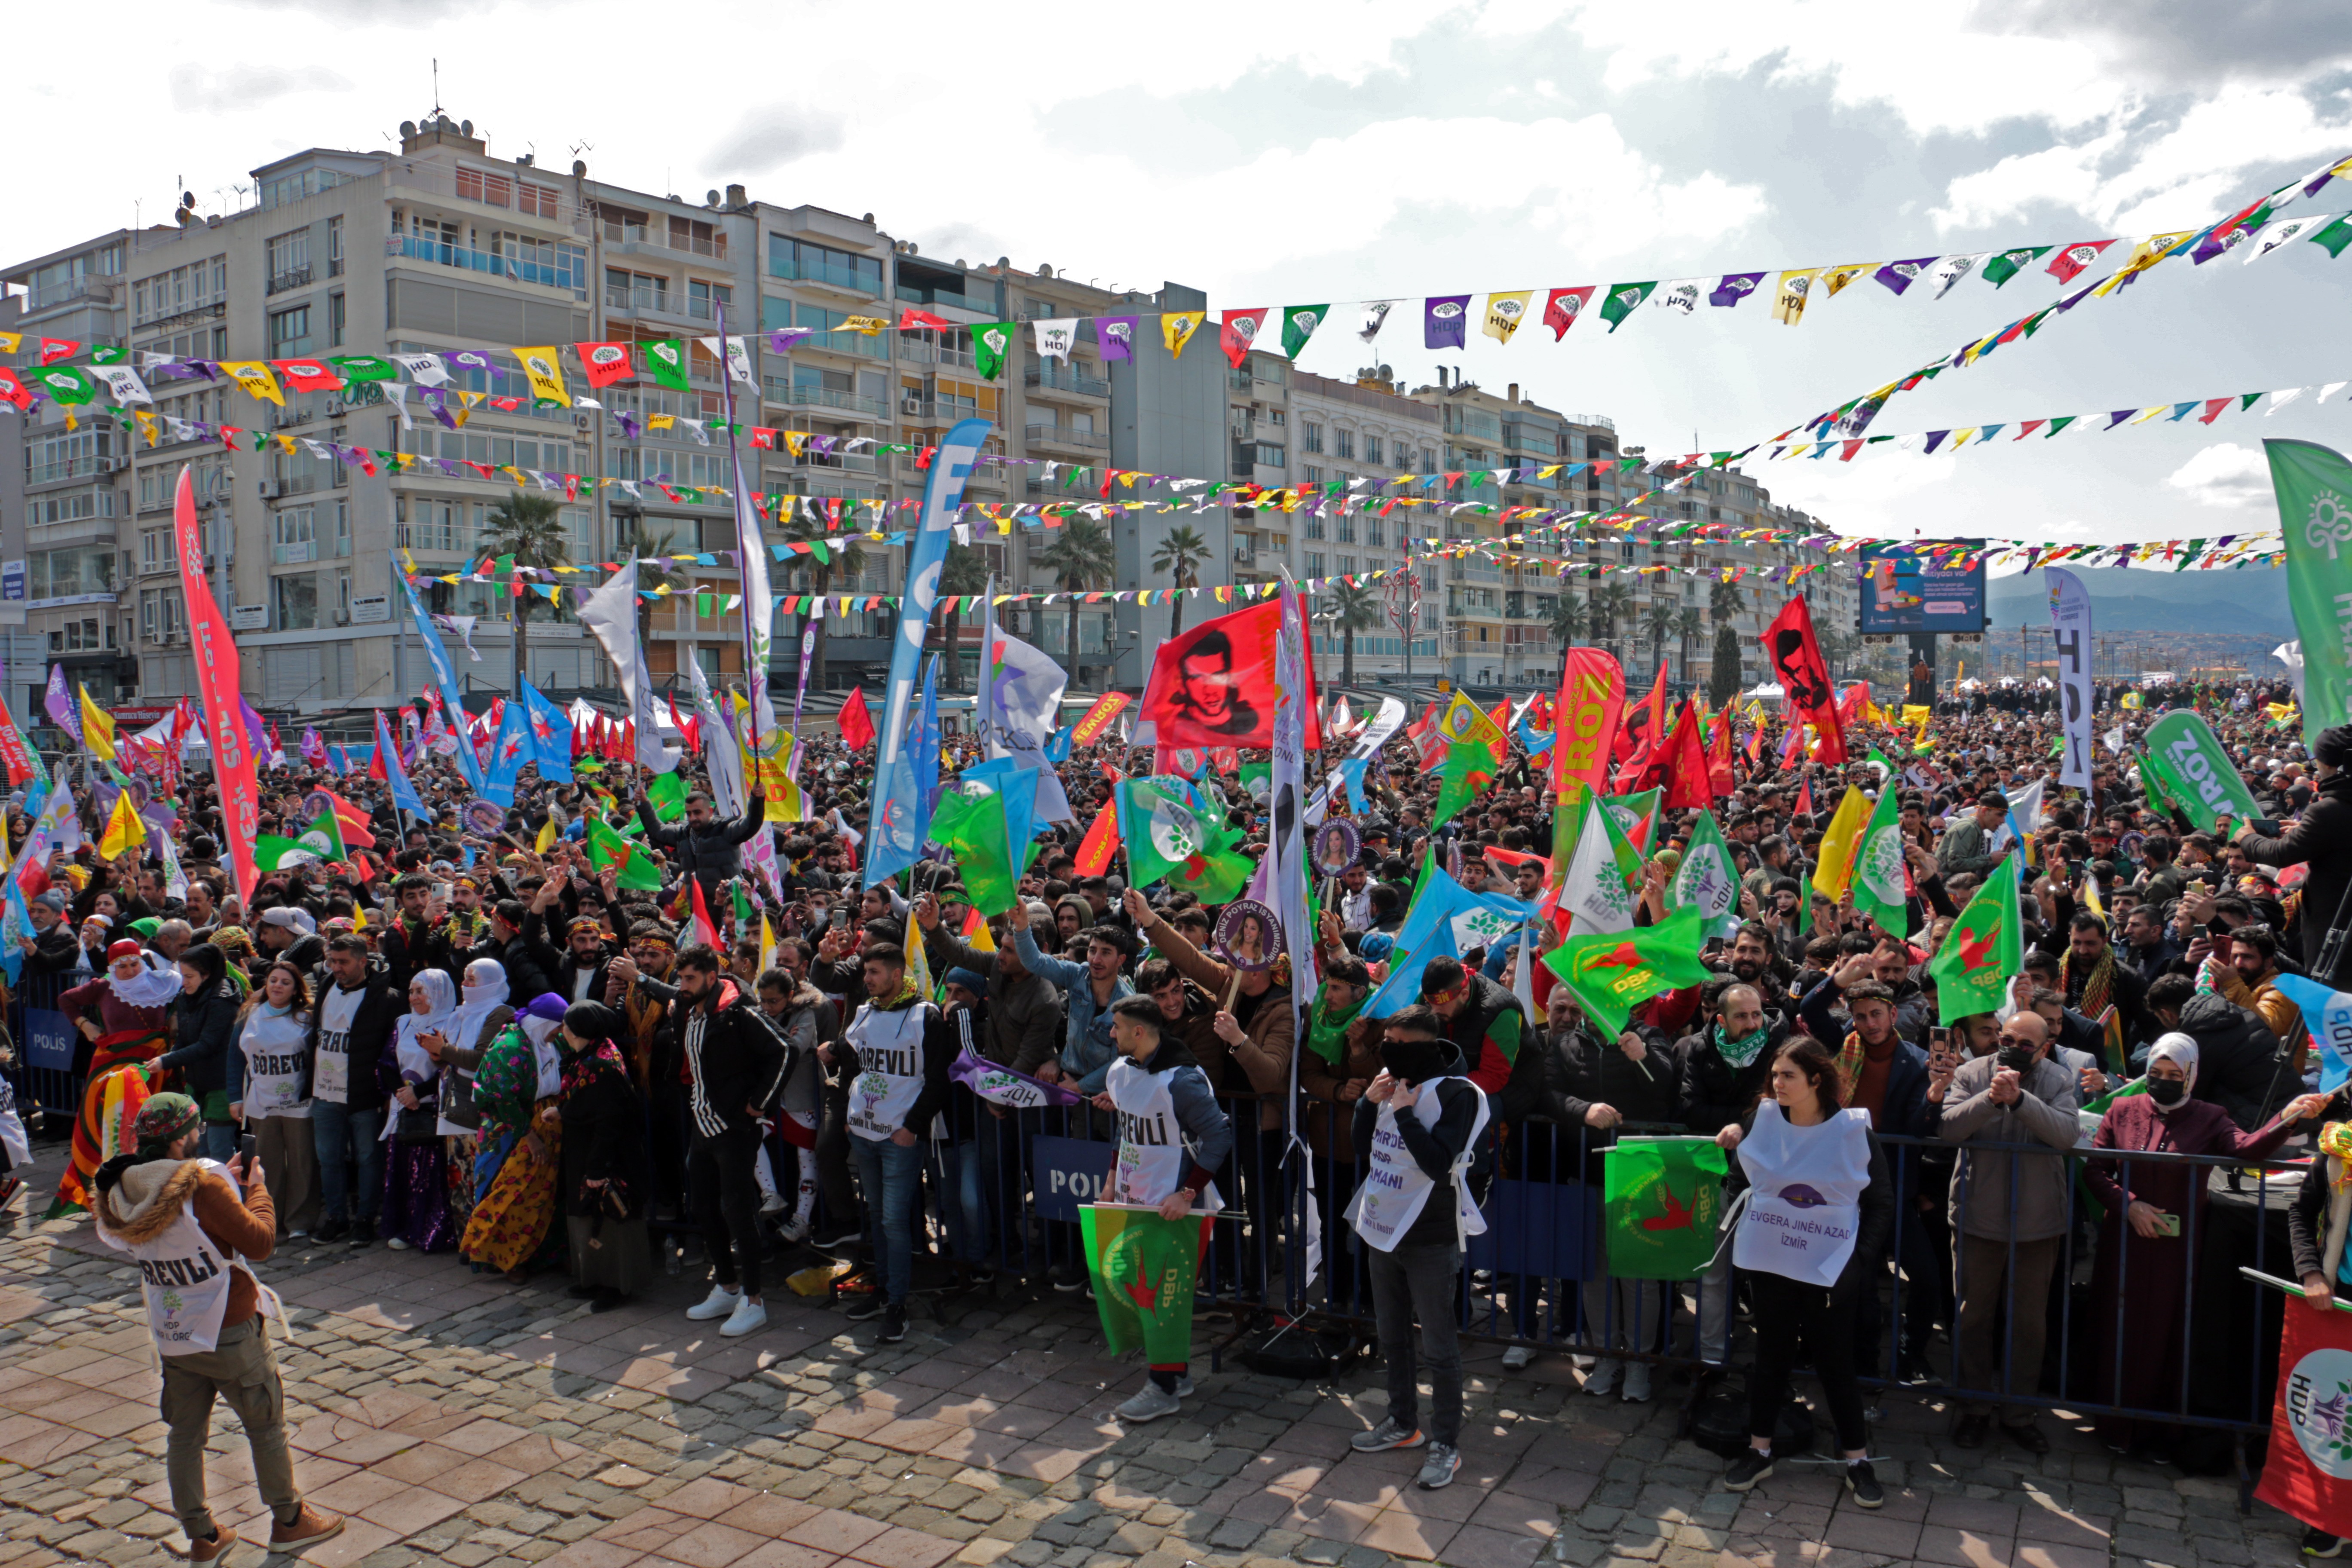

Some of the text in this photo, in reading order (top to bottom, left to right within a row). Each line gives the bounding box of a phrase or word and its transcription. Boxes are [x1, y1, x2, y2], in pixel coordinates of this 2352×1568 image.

[1432, 321, 1461, 334] HDP
[1490, 315, 1518, 334] HDP
[354, 364, 383, 374] HDP
[1574, 673, 1582, 689] BE
[218, 710, 242, 769] SOL
[1317, 819, 1338, 838] POYRAZ
[1339, 818, 1360, 863] İSYANIMIZDIR!
[1583, 893, 1618, 922] HDP
[1219, 903, 1280, 963] DENİZ POYRAZ İSYANIMIZDIR!
[34, 1032, 66, 1051] POLİS
[860, 1041, 916, 1077] ÖREVLİ
[864, 1110, 874, 1120] HDP
[865, 1120, 870, 1130] İL
[1050, 1169, 1102, 1200] POL
[1120, 1182, 1130, 1193] HDP
[1369, 1166, 1403, 1190] AMANI
[1792, 1219, 1822, 1235] JINÊN
[1781, 1232, 1807, 1251] ÎZMÎR
[164, 1320, 180, 1329] HDP
[2291, 1372, 2312, 1427] HDP
